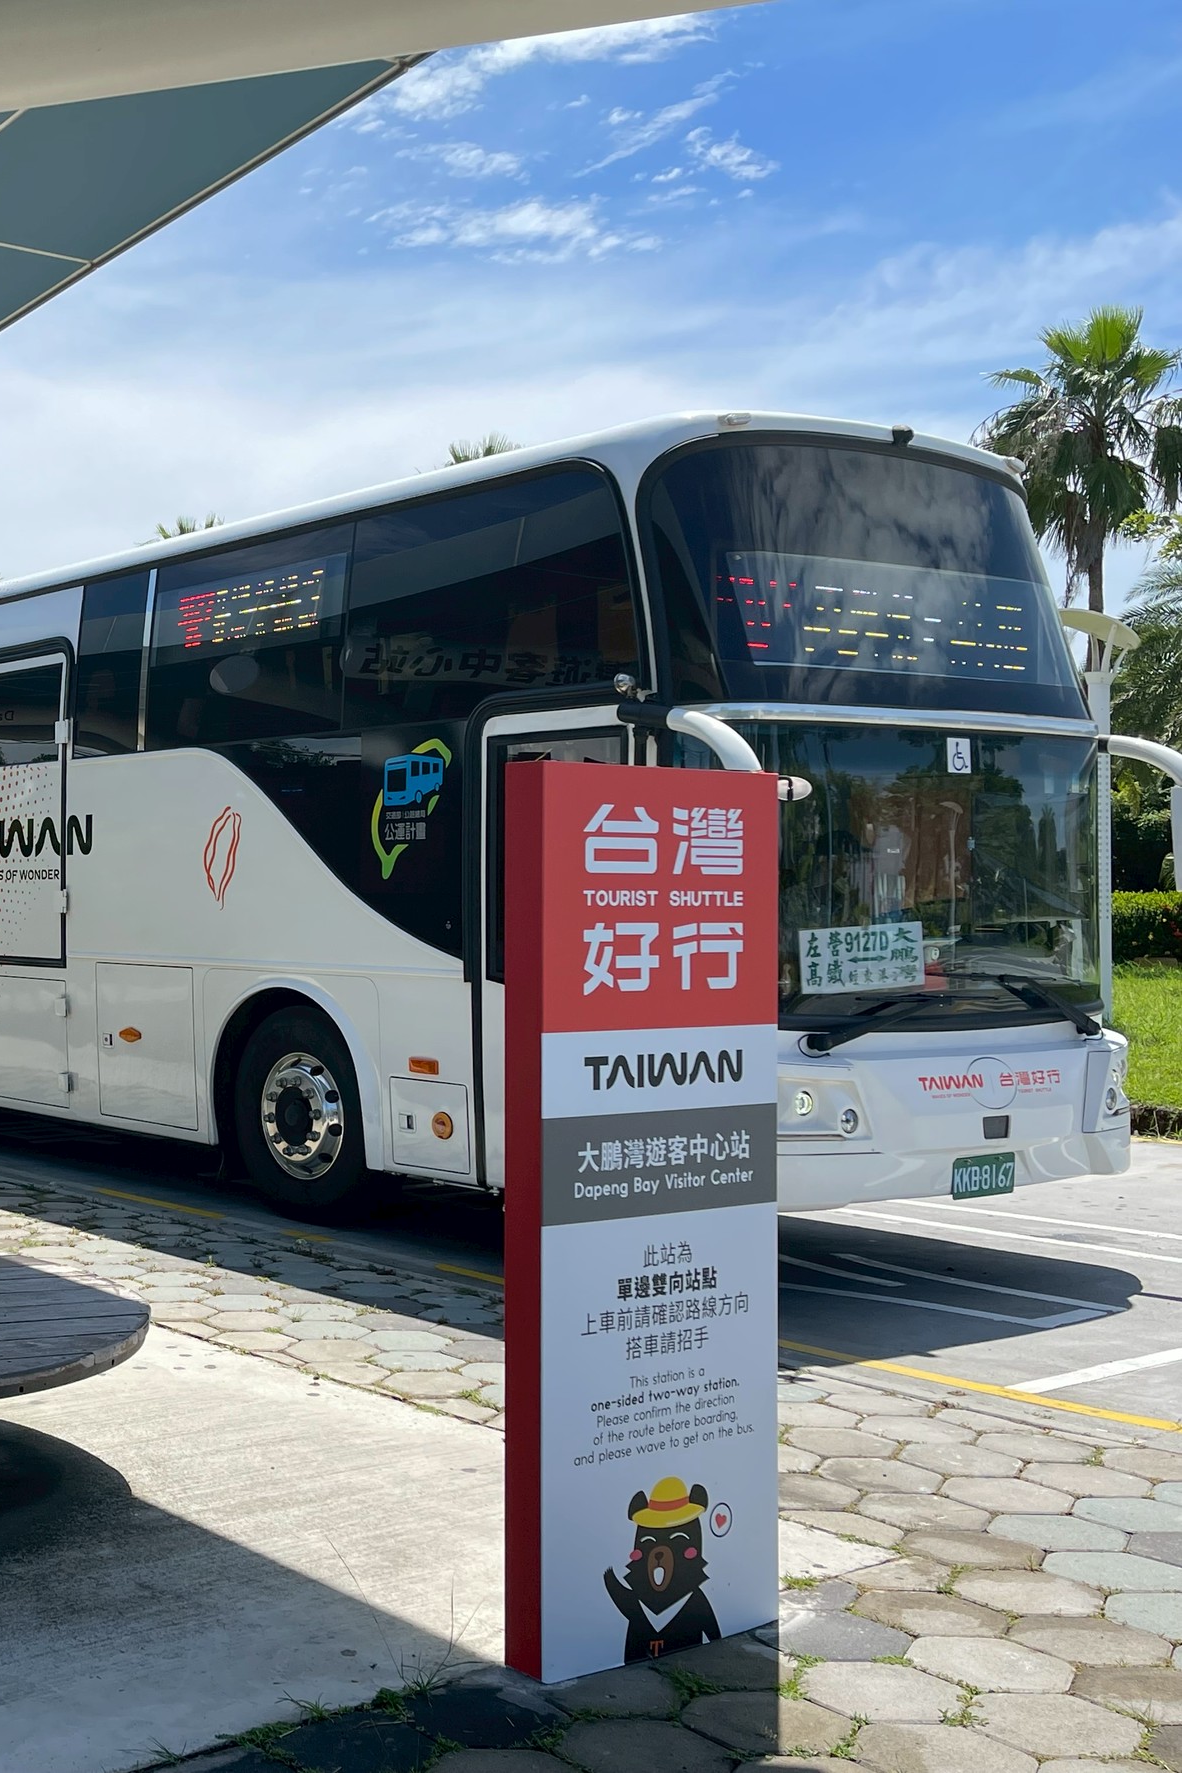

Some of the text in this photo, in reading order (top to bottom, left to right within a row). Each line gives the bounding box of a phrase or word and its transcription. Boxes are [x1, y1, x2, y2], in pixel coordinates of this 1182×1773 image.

[583, 804, 744, 876] 台灣
[5, 869, 18, 881] OF
[19, 868, 60, 881] WONDER
[583, 889, 744, 907] TOURIST SHUTTLE
[844, 930, 889, 953] 9127D
[583, 922, 744, 996] 好行
[584, 1049, 744, 1091] TAIWAN
[918, 1073, 984, 1091] TAIWAN
[999, 1069, 1061, 1087] 台灣好行
[577, 1130, 750, 1174] 大鵬灣遊客中心站
[574, 1167, 754, 1201] Dapeng Bay Visitor Center
[954, 1162, 1014, 1193] KKB-8167
[643, 1240, 693, 1268] 此站為
[617, 1265, 718, 1302] 單邊雙向站點
[580, 1290, 749, 1337] 上車前請確認路線方向
[625, 1325, 710, 1361] 搭車請招手
[590, 1376, 741, 1413] one-sided two-way station.
[629, 1367, 705, 1389] This station is a
[596, 1394, 735, 1429] Please confirm the direction
[573, 1422, 755, 1467] and please wave to get on the bus.
[593, 1433, 604, 1446] of
[607, 1430, 625, 1443] the
[628, 1425, 655, 1440] route
[658, 1418, 691, 1434] before
[649, 1640, 664, 1657] T
